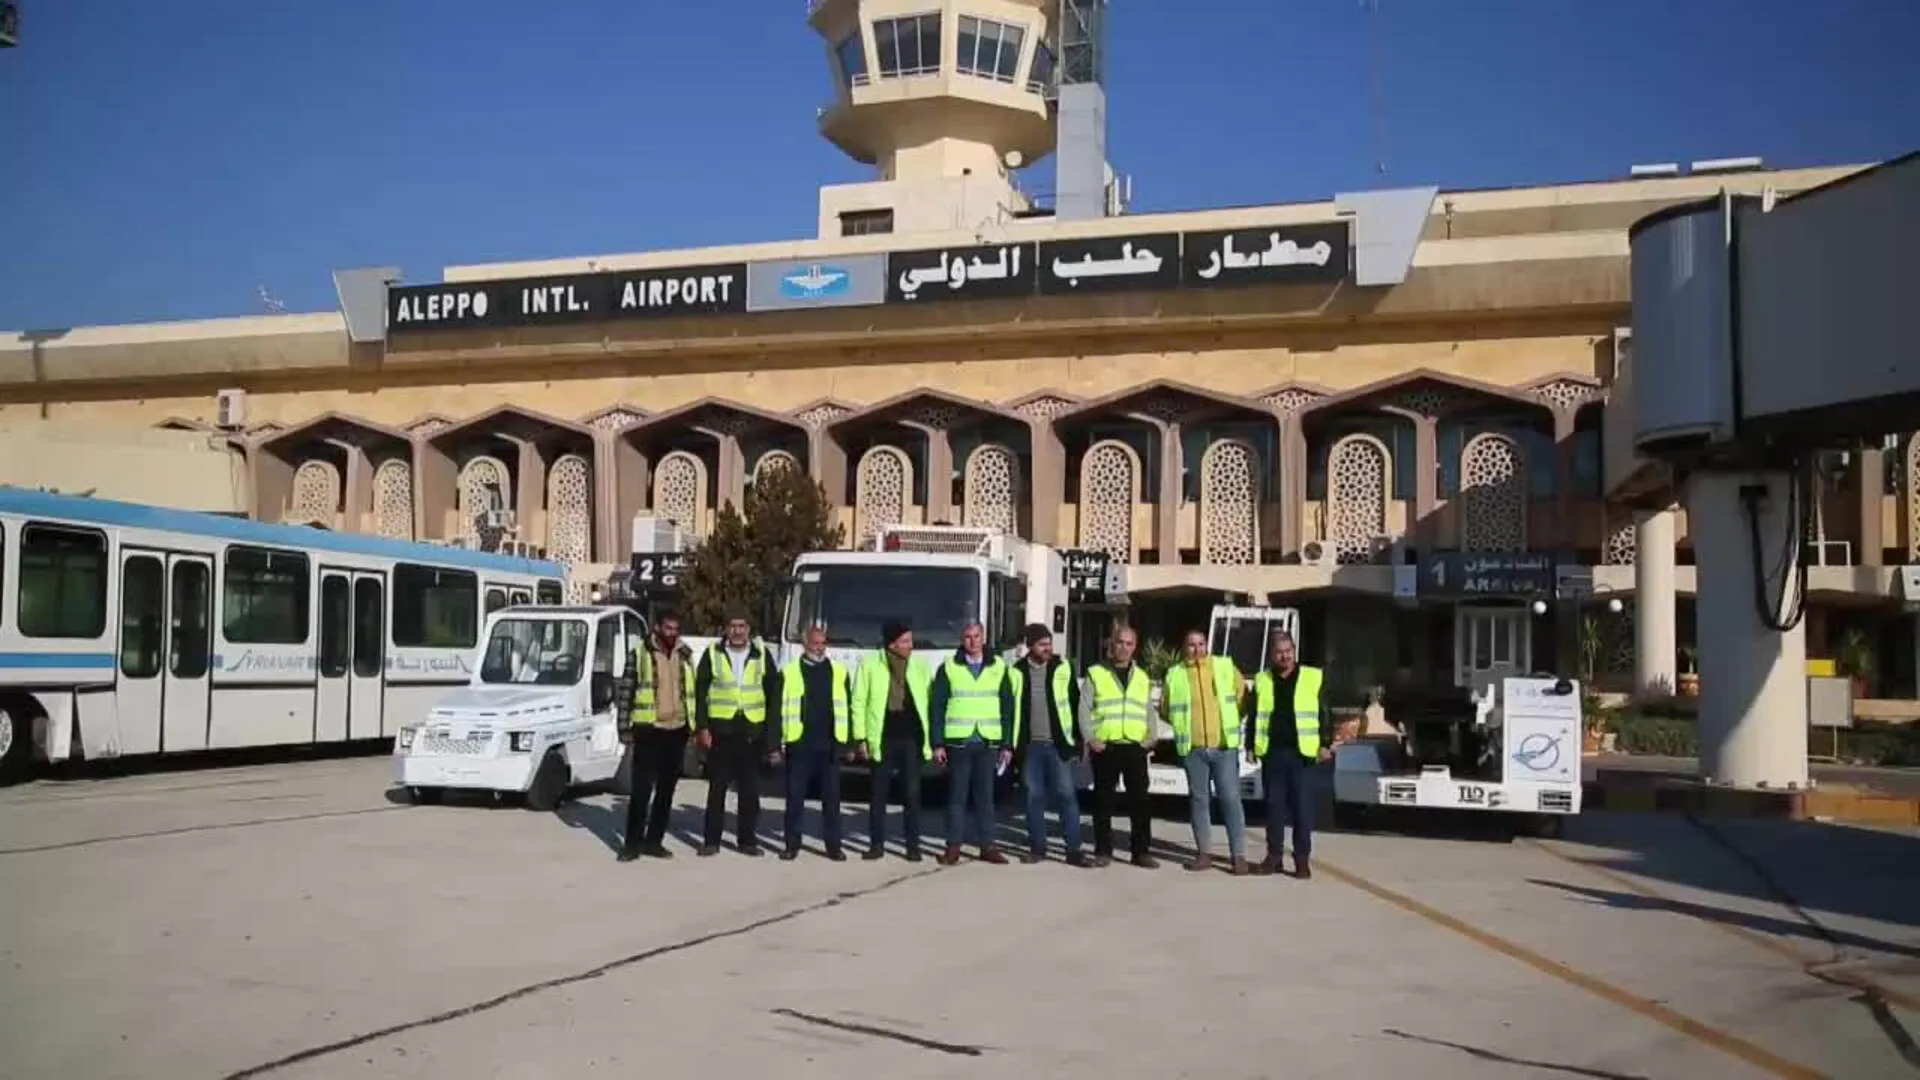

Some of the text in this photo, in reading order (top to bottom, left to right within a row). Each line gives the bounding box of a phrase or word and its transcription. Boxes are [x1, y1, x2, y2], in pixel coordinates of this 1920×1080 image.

[900, 232, 1331, 300] مطار حلب الدولي
[396, 275, 734, 322] ALEPPO INTL. AIRPORT
[640, 559, 653, 580] 2
[1431, 560, 1446, 587] 1
